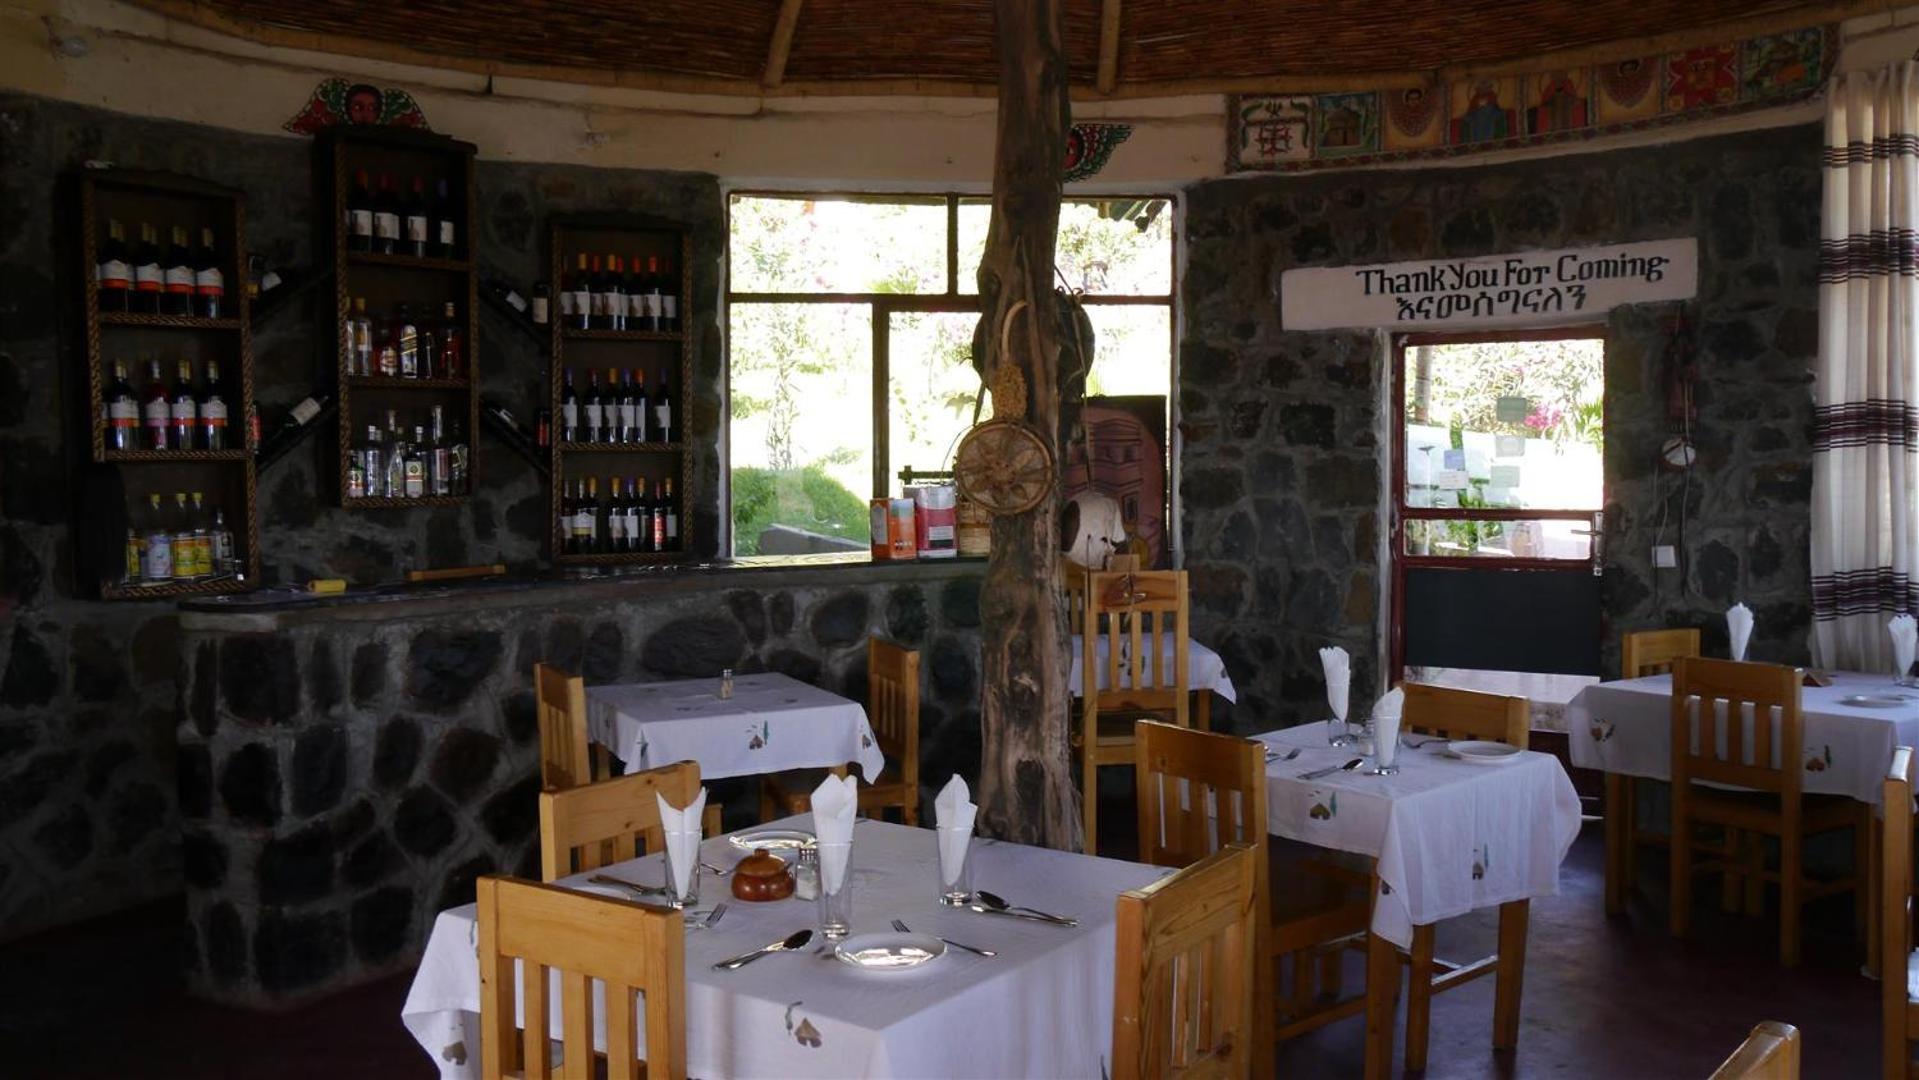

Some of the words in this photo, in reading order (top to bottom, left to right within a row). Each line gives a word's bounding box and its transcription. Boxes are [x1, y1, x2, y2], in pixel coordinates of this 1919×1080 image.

[1355, 265, 1446, 296] Thank
[1447, 263, 1498, 291] You
[1504, 258, 1550, 287] For
[1557, 252, 1670, 283] Coming
[1396, 284, 1587, 321] እናመሰግናለን
